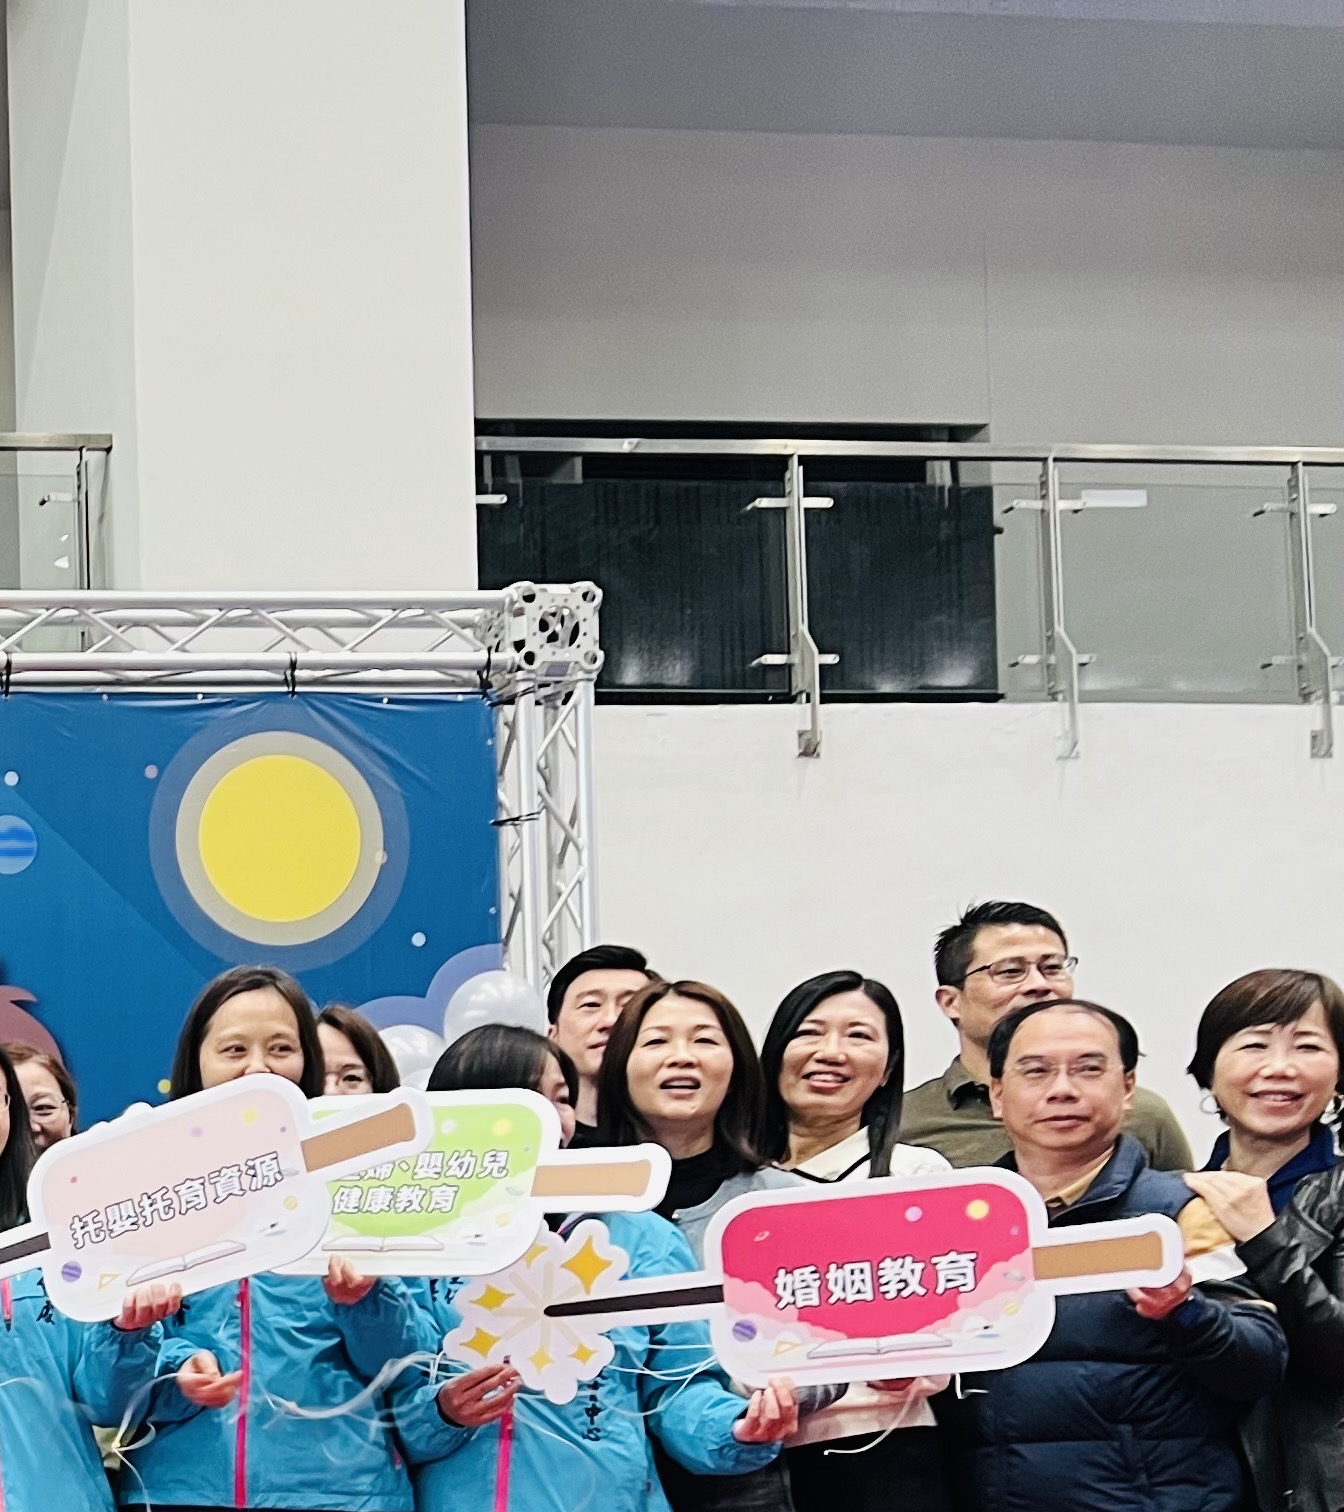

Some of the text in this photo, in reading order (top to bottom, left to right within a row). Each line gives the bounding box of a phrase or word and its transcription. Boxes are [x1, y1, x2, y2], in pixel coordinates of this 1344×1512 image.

[341, 1149, 511, 1182] 、嬰幼兒
[68, 1150, 286, 1250] 托嬰托育資源
[331, 1183, 460, 1215] 健康教育
[774, 1250, 979, 1310] 婚姻教育
